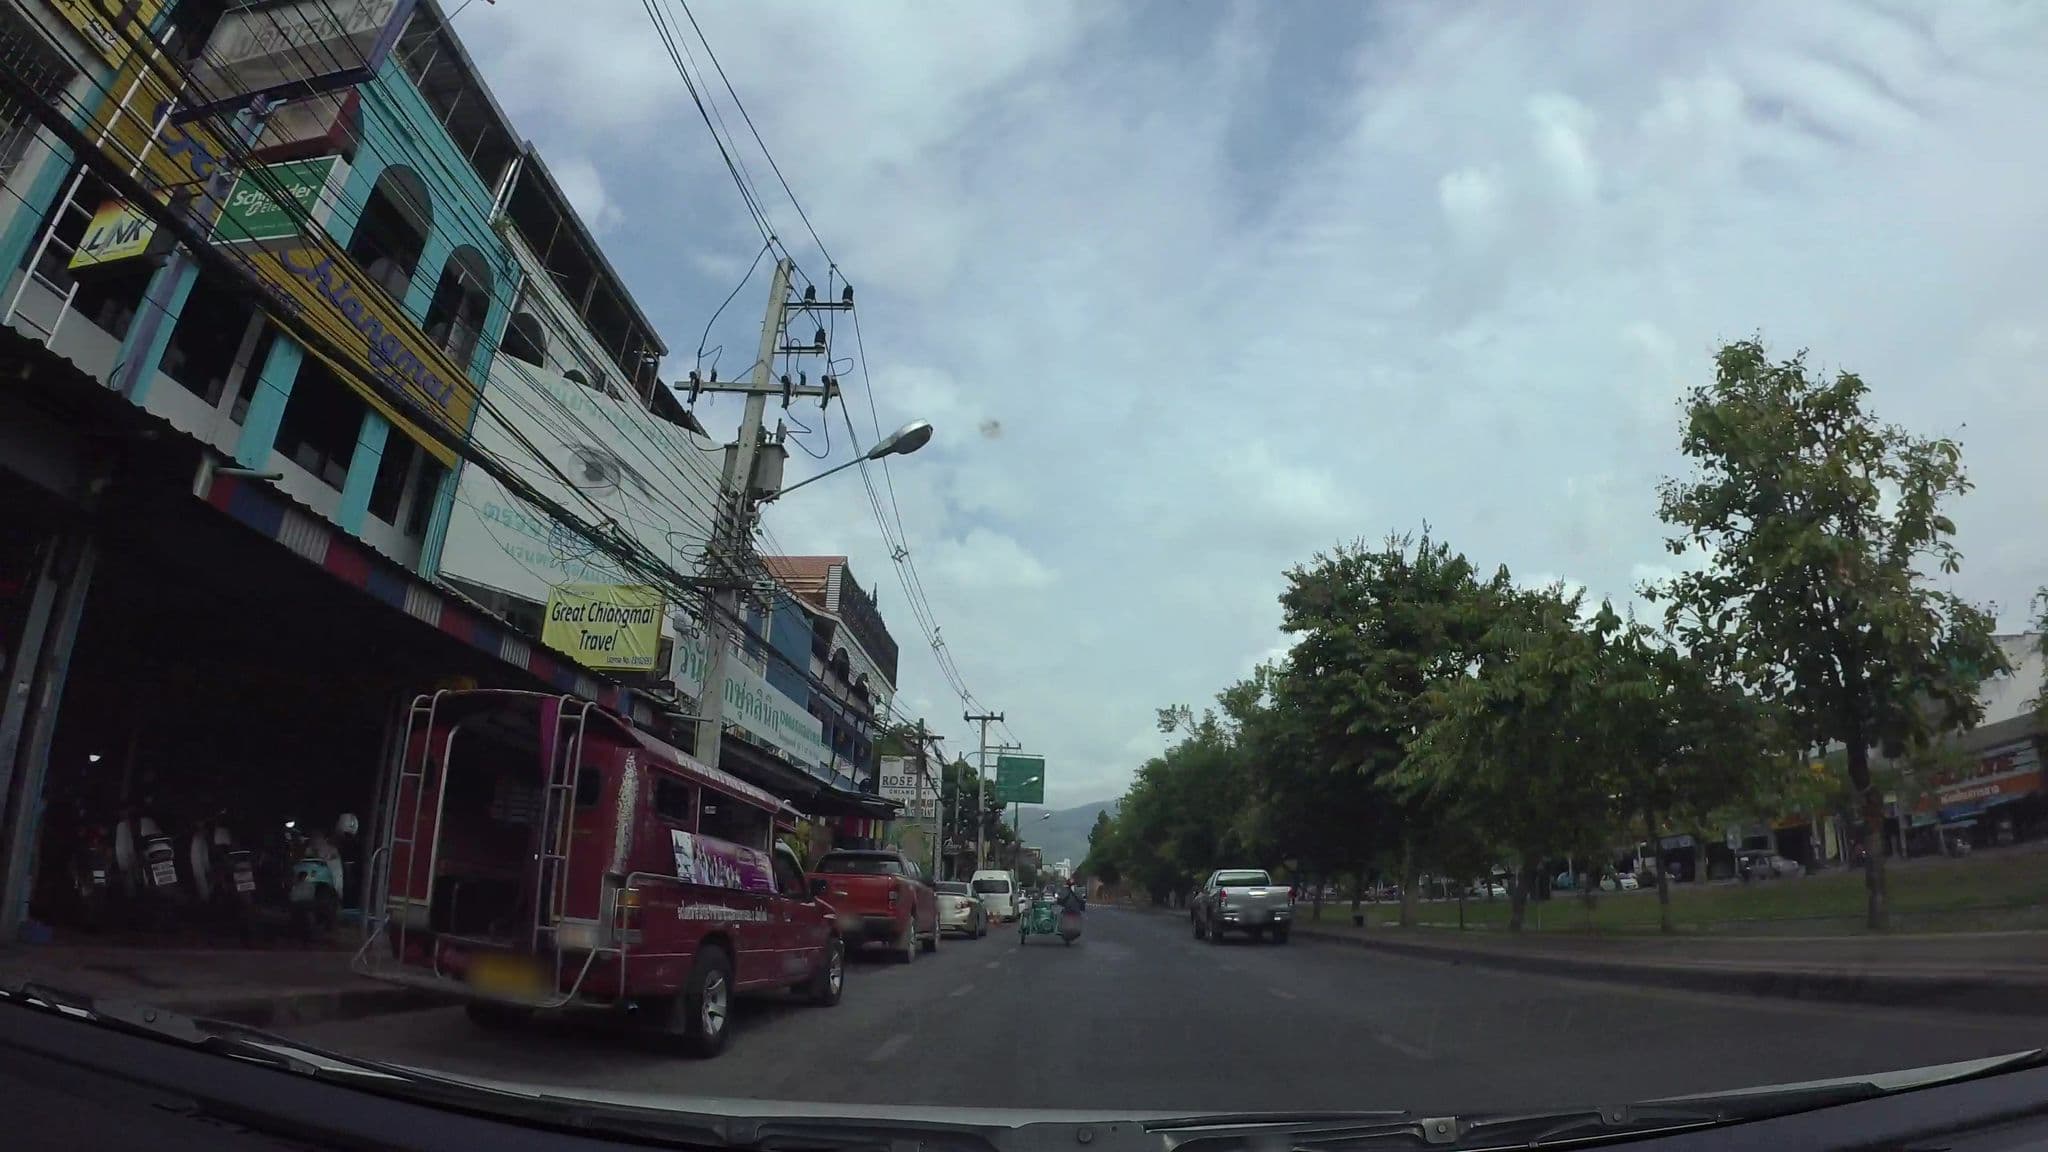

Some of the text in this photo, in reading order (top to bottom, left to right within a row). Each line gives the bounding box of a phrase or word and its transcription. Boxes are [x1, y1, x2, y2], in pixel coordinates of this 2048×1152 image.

[233, 183, 316, 206] Schder
[552, 601, 655, 627] Great Chiangmai
[579, 629, 618, 651] Travel
[882, 775, 940, 788] ROSETE
